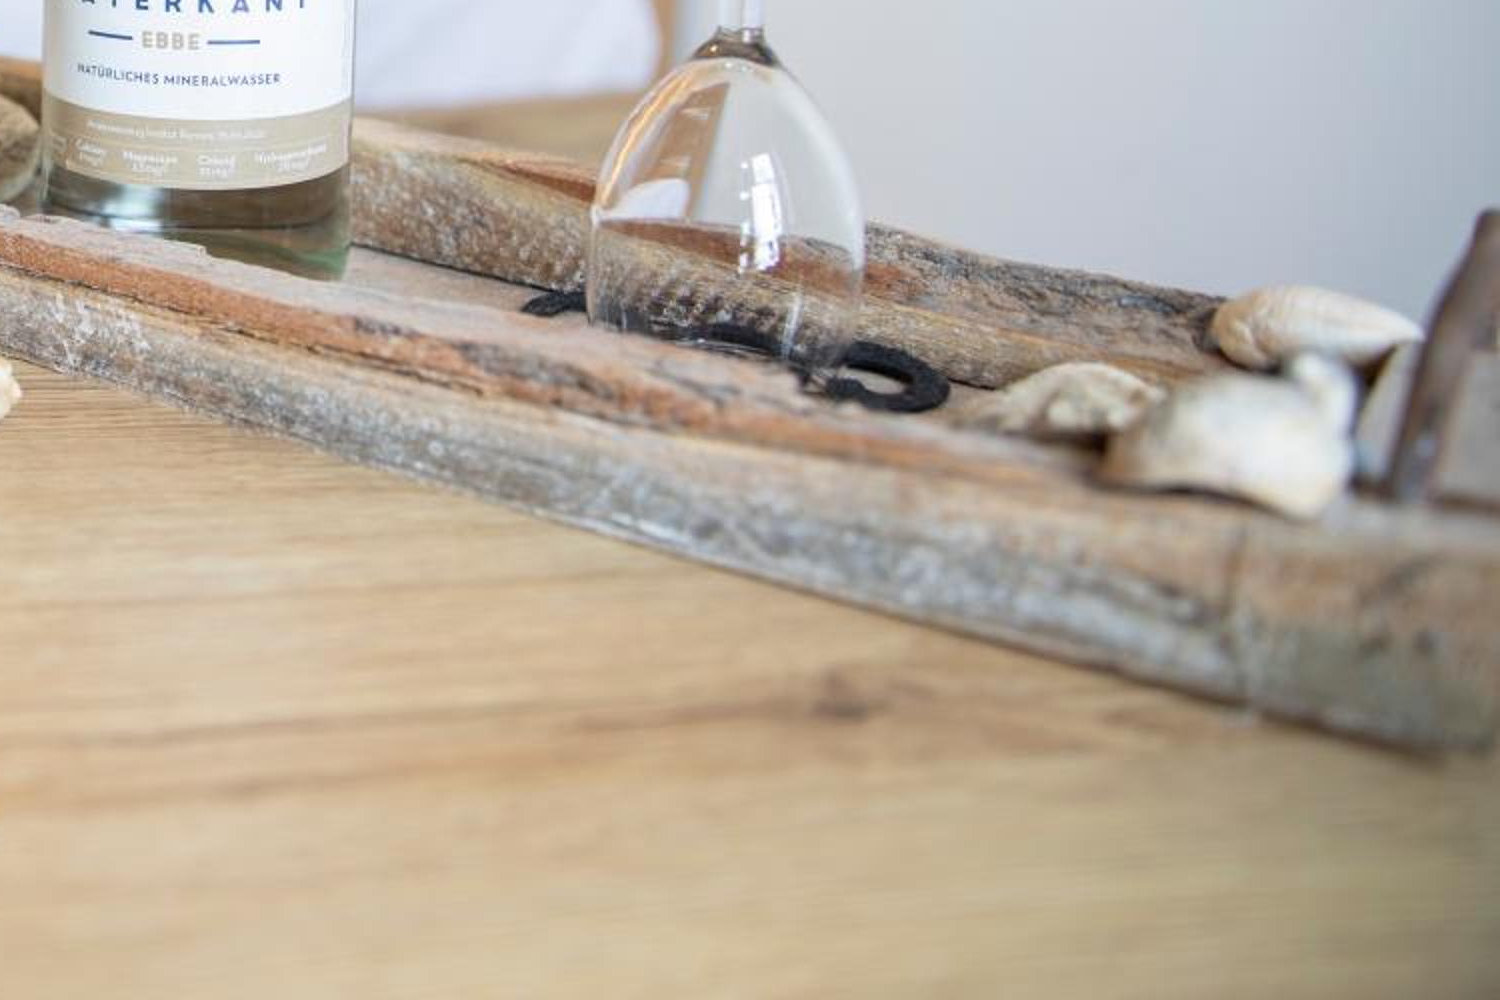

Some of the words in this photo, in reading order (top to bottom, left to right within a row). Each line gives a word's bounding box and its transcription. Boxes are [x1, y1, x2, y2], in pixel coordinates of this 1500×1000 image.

[141, 31, 200, 50] EBBE
[77, 63, 160, 85] NATÜRLICHES
[163, 73, 281, 87] MINERALWASSER
